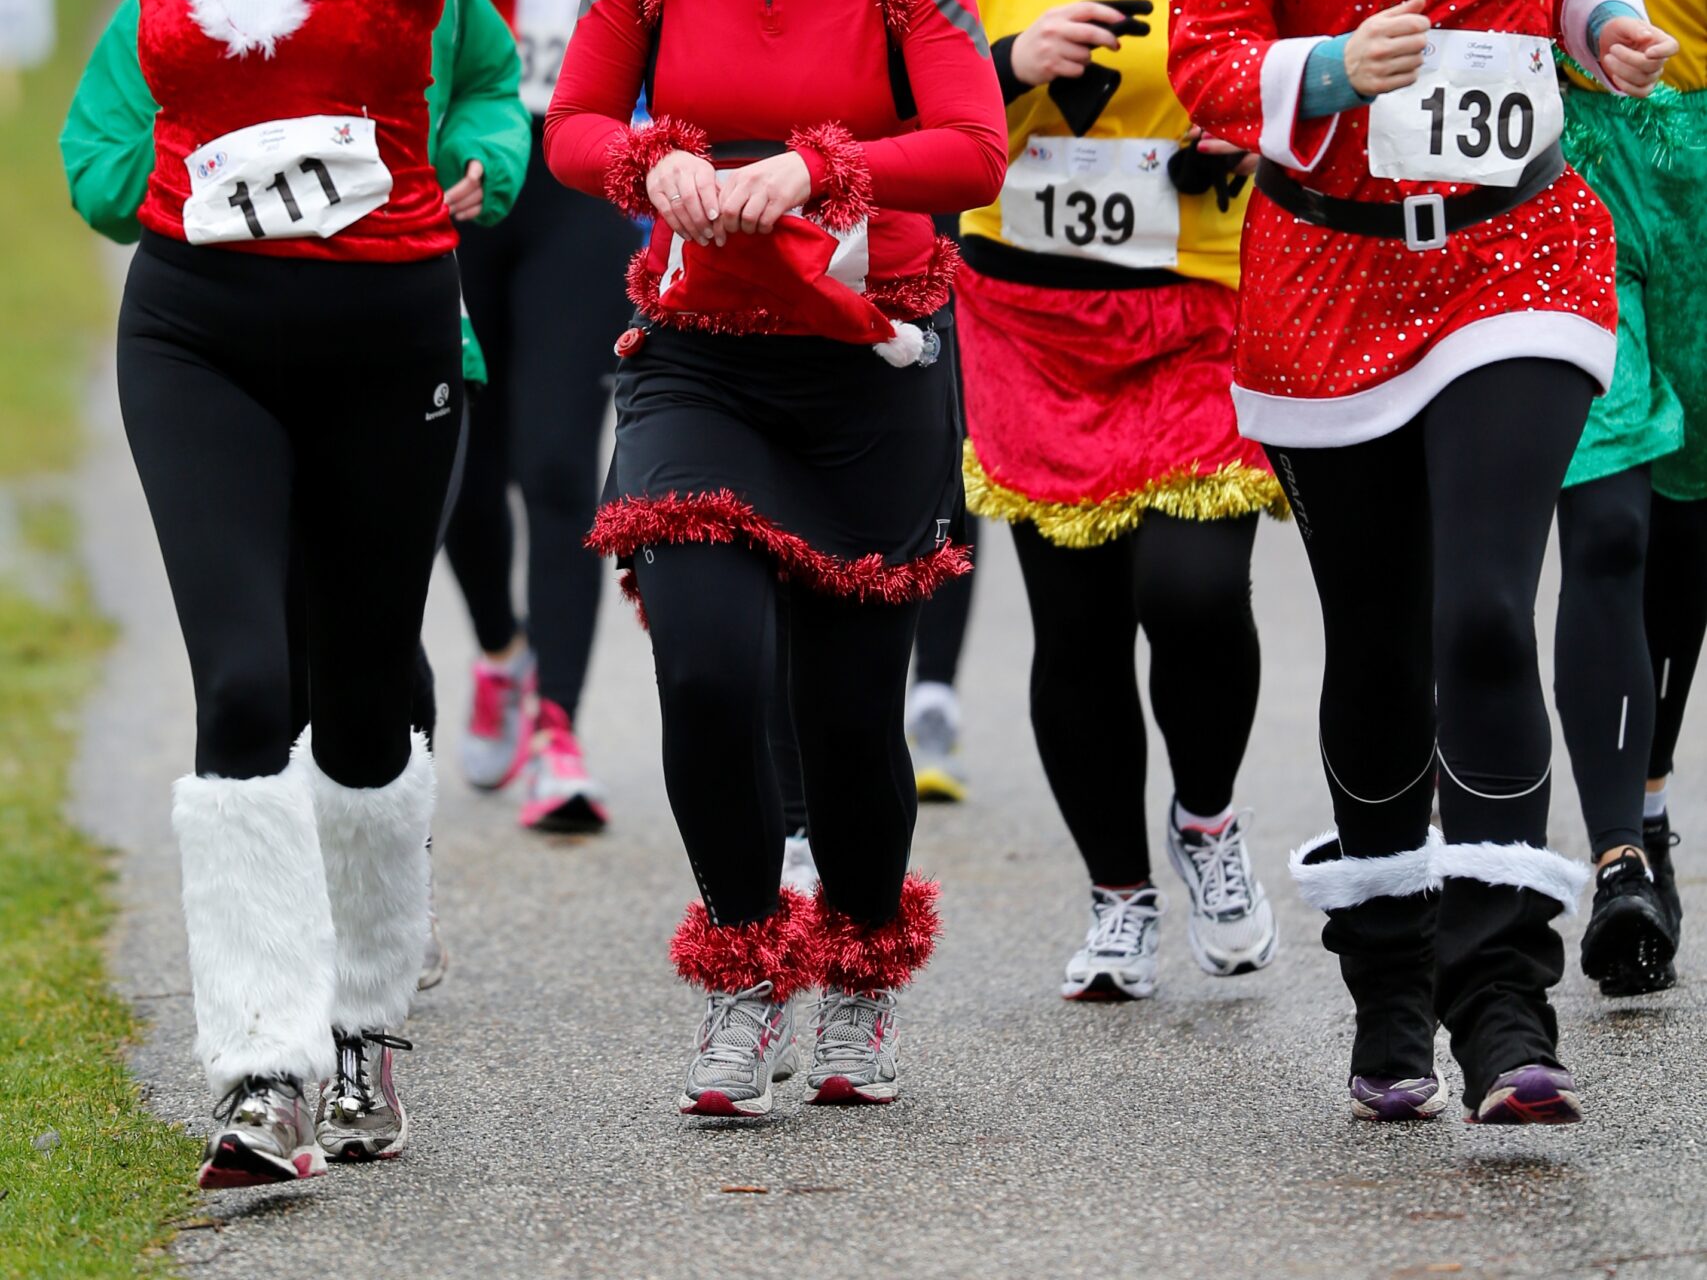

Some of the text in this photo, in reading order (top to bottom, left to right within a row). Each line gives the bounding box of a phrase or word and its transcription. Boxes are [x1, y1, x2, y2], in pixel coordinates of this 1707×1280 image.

[1421, 87, 1534, 160] 130
[228, 157, 341, 239] 111
[1035, 184, 1135, 246] 139
[1280, 453, 1309, 523] CRAFT
